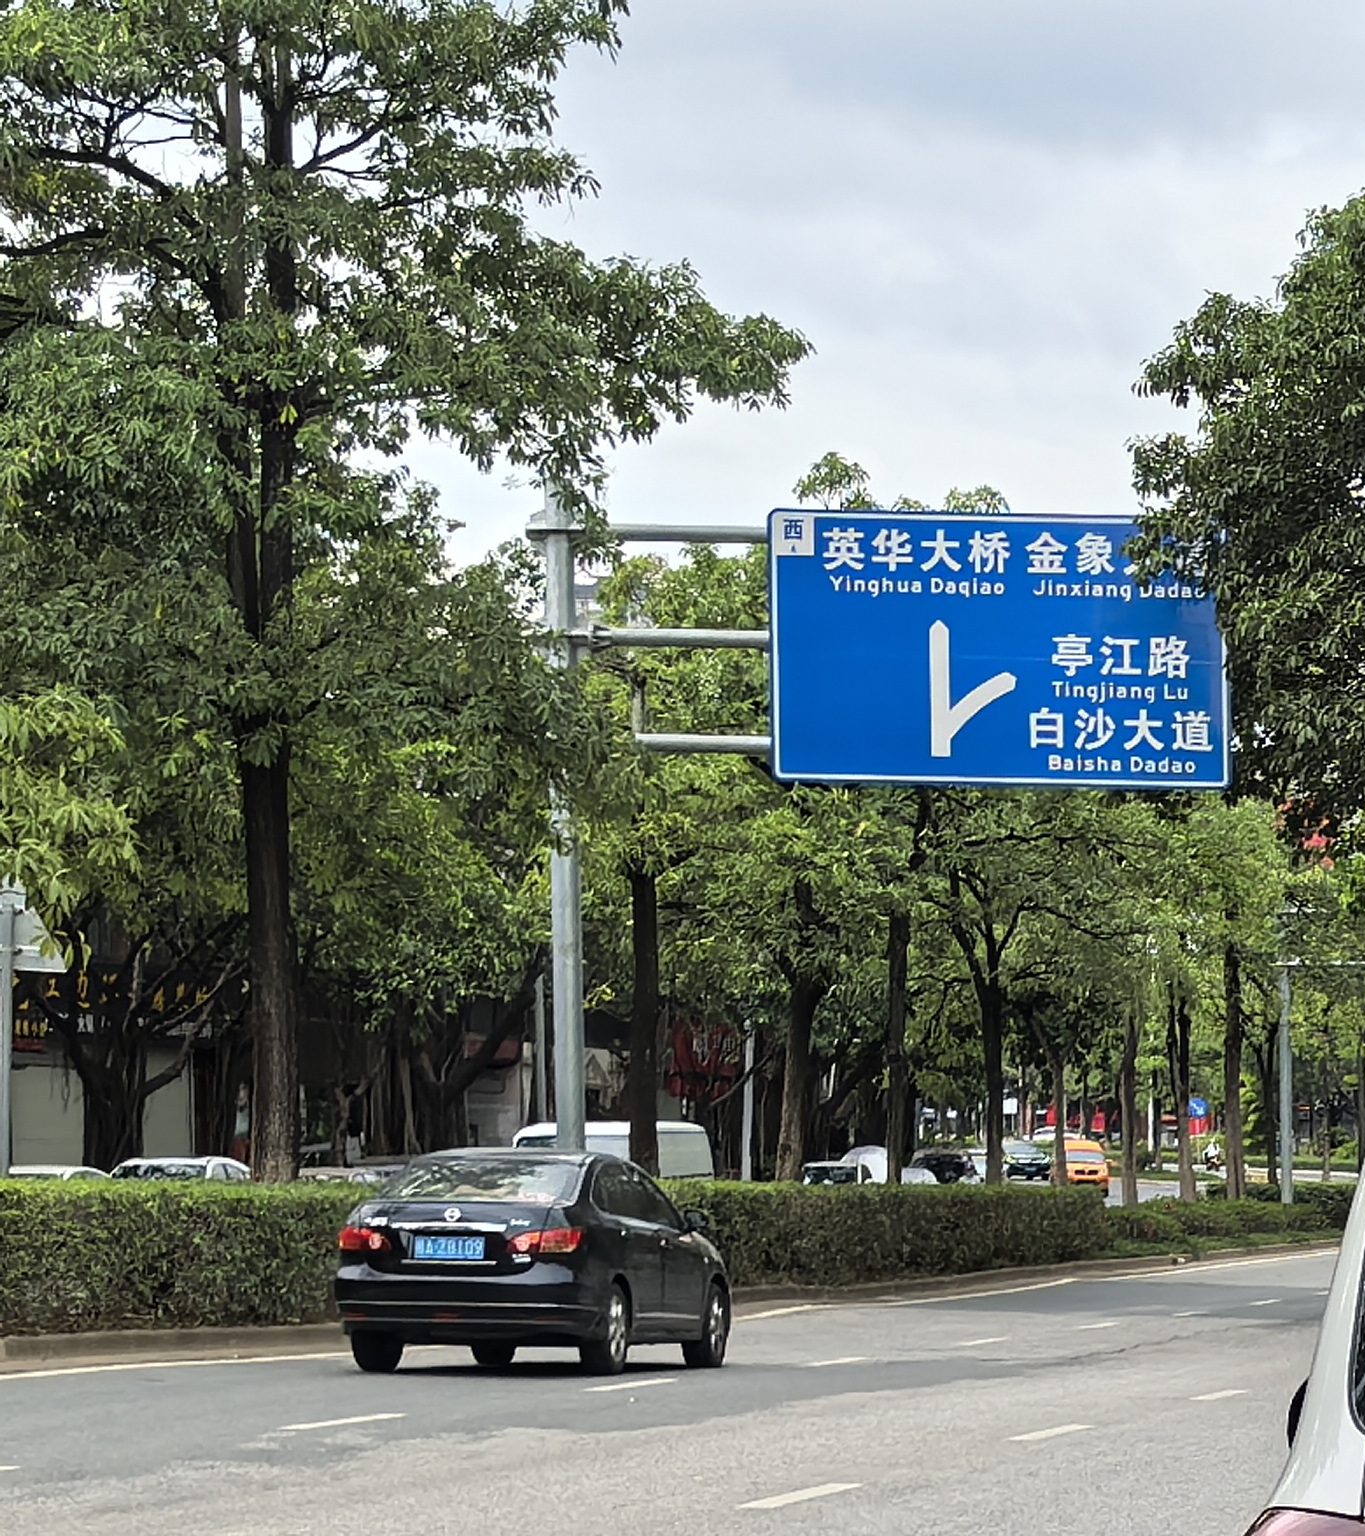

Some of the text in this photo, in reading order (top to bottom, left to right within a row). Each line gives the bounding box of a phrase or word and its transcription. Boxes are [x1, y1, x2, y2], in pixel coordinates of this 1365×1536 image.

[783, 518, 804, 540] 西
[822, 526, 1208, 577] 英华大桥 金象
[829, 575, 923, 598] Yinghua
[930, 576, 1006, 598] Daqiao
[1032, 579, 1132, 602] Jinxiang
[1051, 633, 1191, 679] 亭江路
[1051, 681, 1189, 704] Tingjiang Lu
[1029, 706, 1214, 753] 白沙大道
[1047, 754, 1197, 774] Baisha Dadao
